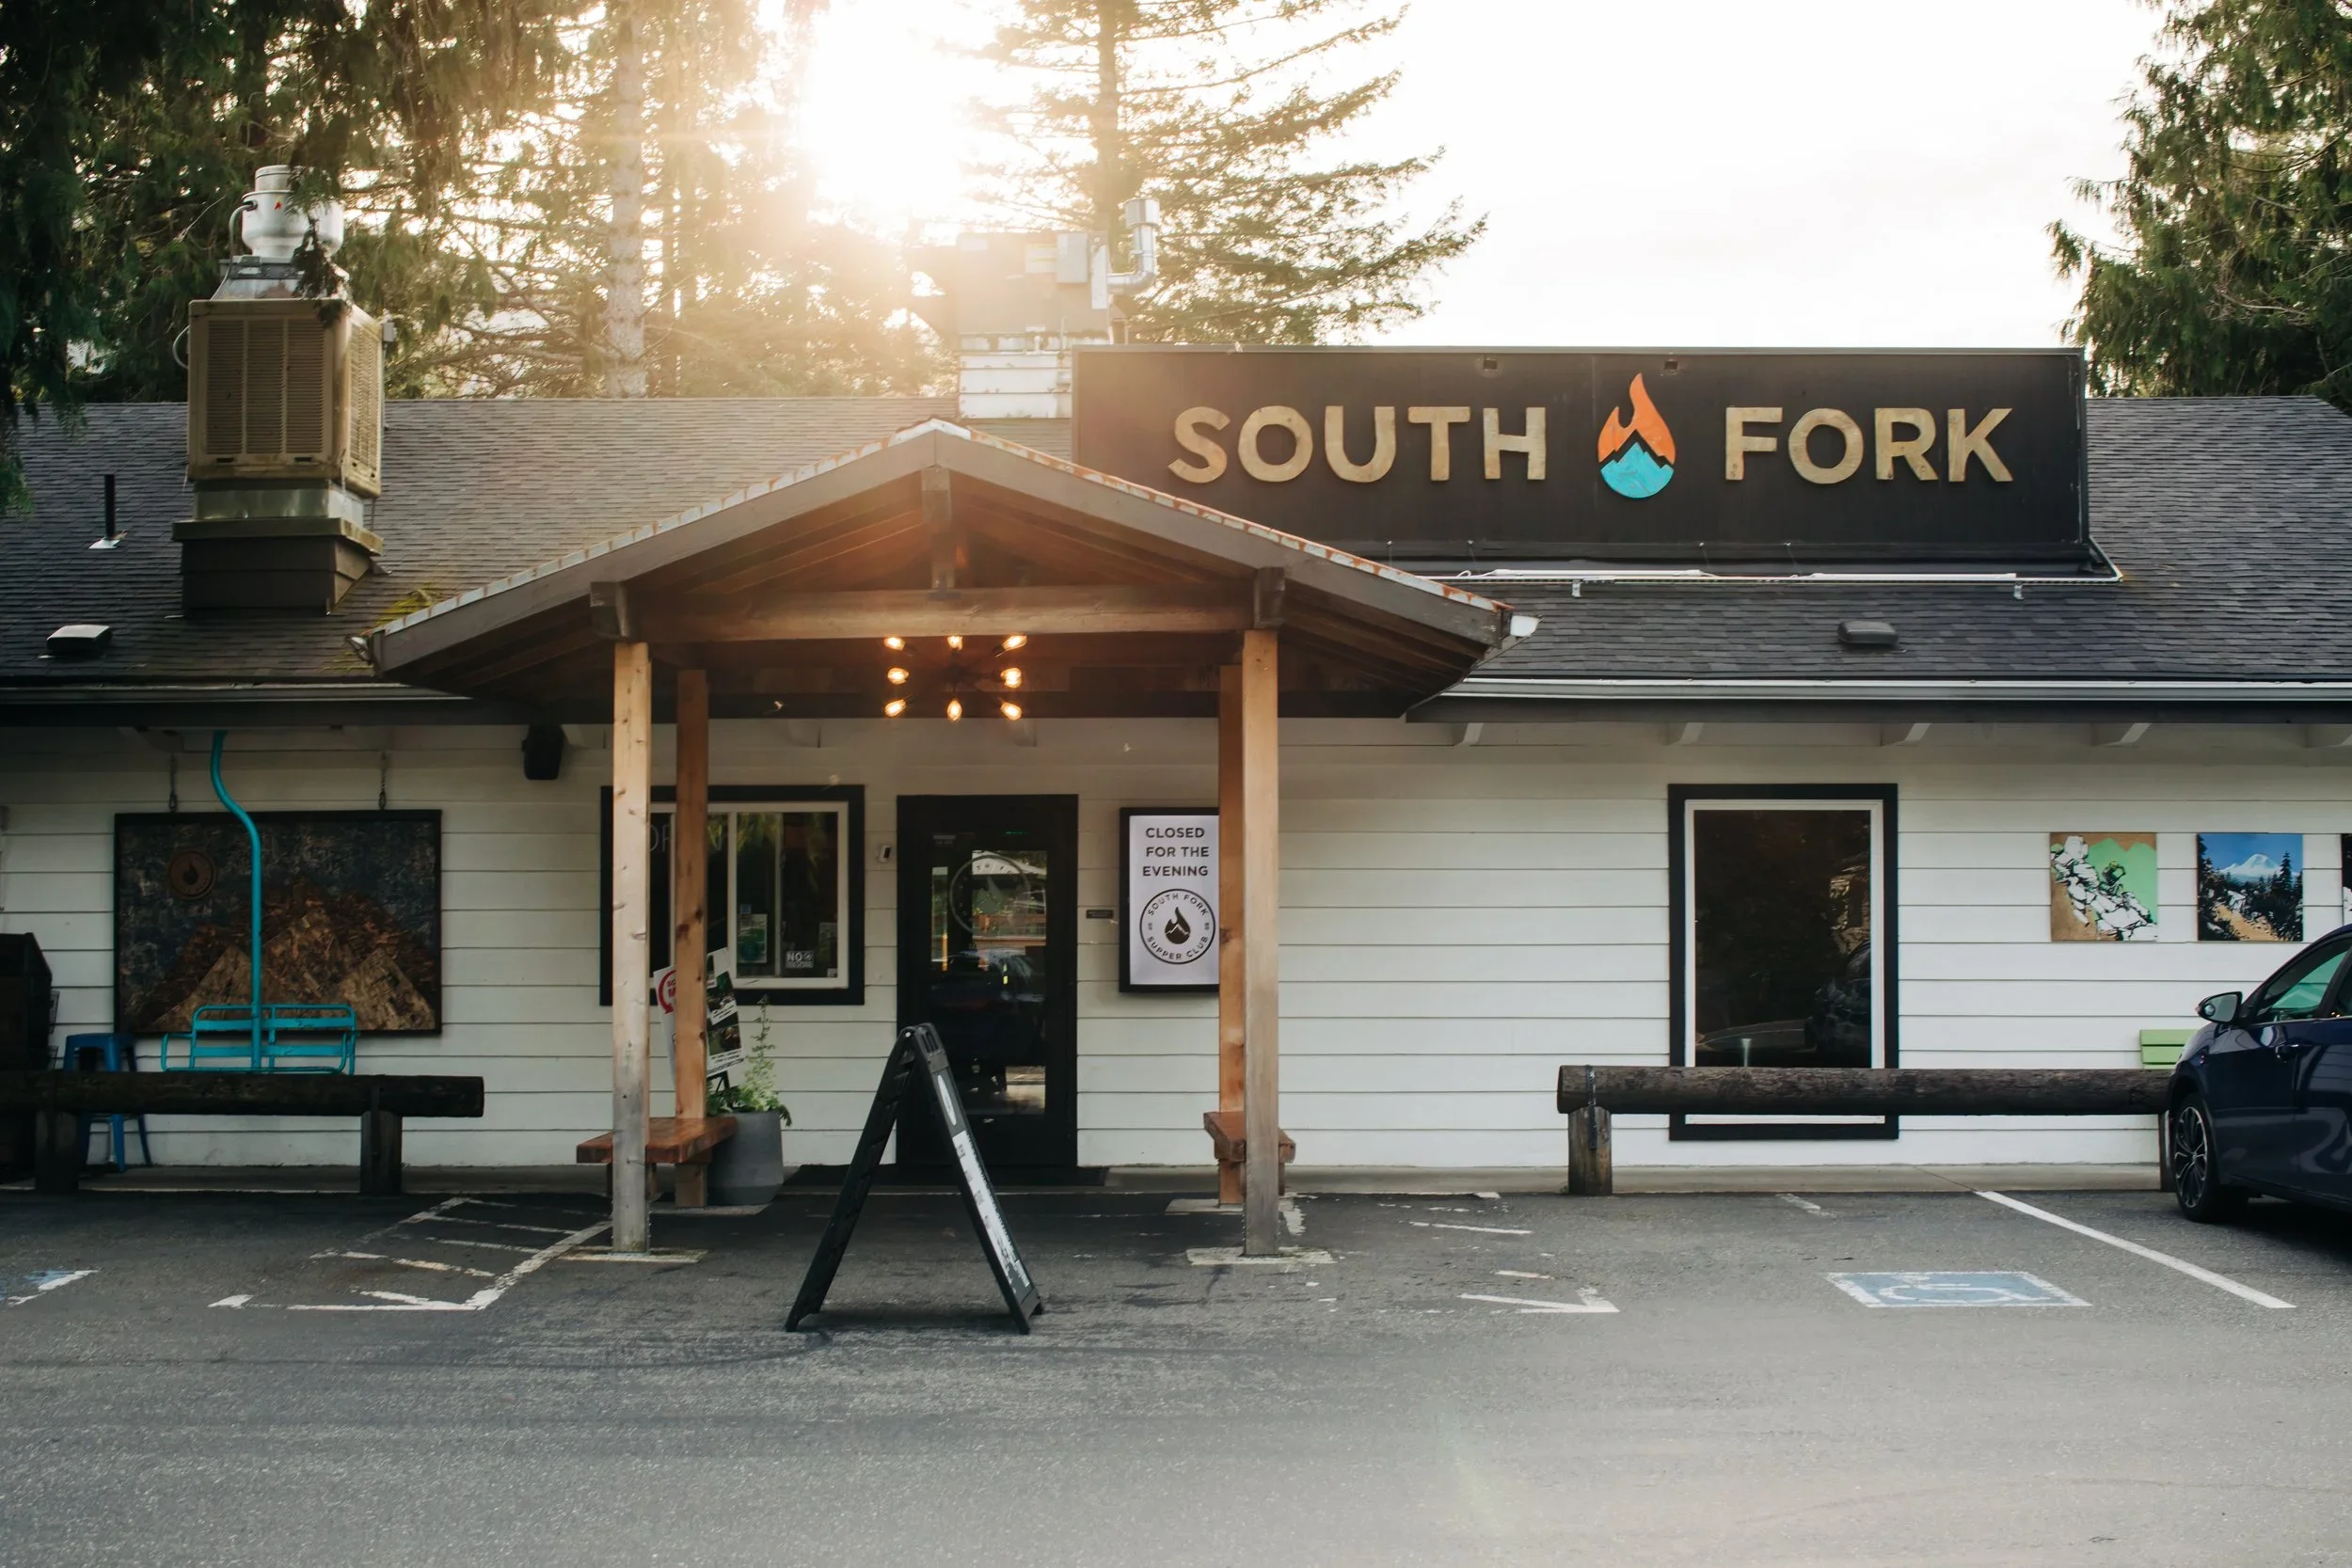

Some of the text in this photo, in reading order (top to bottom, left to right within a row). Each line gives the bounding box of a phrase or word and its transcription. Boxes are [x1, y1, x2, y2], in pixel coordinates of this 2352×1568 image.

[1167, 405, 2014, 484] SOUTH FORK
[1145, 827, 1205, 839] CLOSED
[1146, 847, 1210, 858] FOR THE
[1141, 865, 1209, 877] EVENING
[1148, 893, 1209, 916] SOUTH FORK
[1147, 936, 1209, 960] SUPPER CLUB
